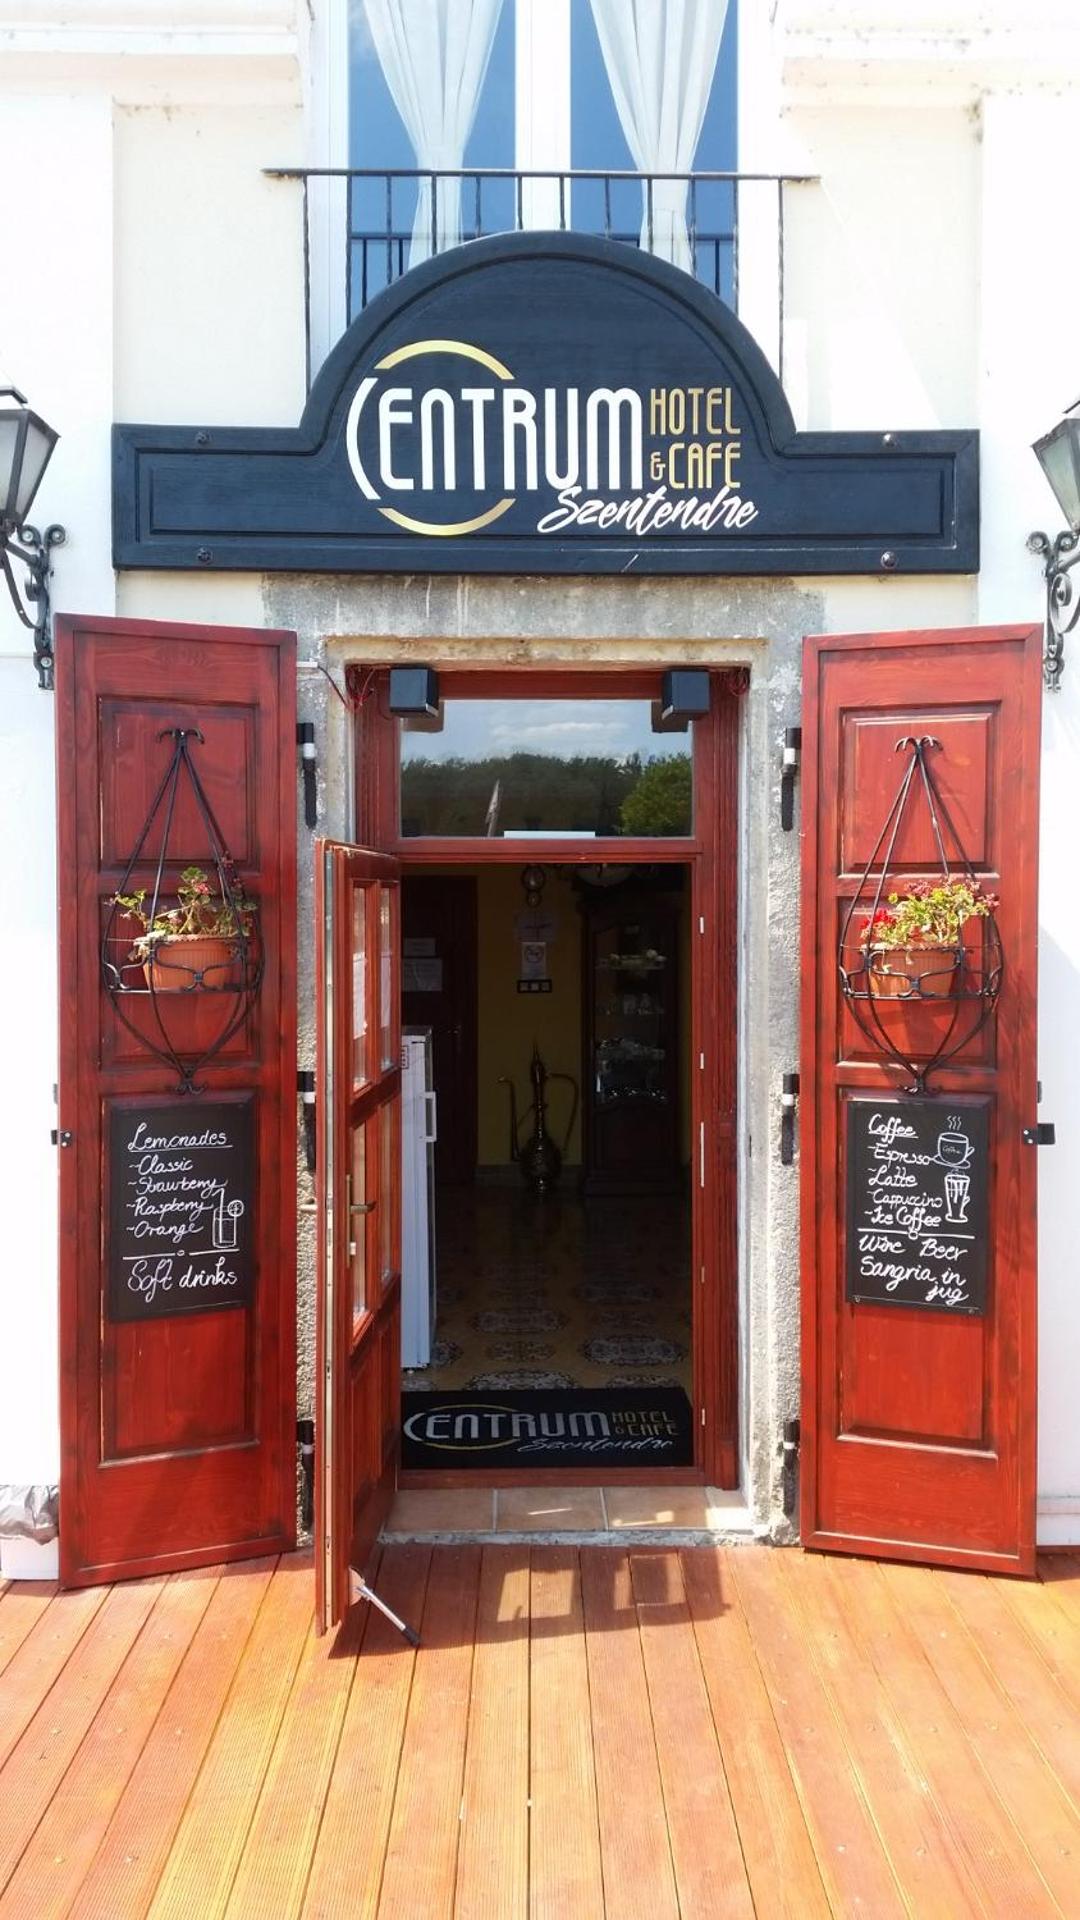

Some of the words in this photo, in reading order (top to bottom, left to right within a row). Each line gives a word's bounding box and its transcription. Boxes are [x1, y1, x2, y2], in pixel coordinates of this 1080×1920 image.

[649, 388, 741, 435] HOTEL
[346, 377, 643, 500] CENTRUM
[537, 485, 759, 535] Szentendre
[128, 1123, 228, 1150] Lemonades
[869, 1113, 917, 1144] Coffee
[896, 1206, 942, 1232] Coffee
[859, 1234, 906, 1253] Wine
[919, 1238, 968, 1261] Beer
[128, 1258, 173, 1303] Soft
[179, 1256, 238, 1289] drinks
[860, 1256, 936, 1291] Sangria
[941, 1267, 967, 1287] in
[926, 1280, 969, 1306] jug
[403, 1411, 611, 1441] CENTRUM
[612, 1411, 674, 1425] HOTEL
